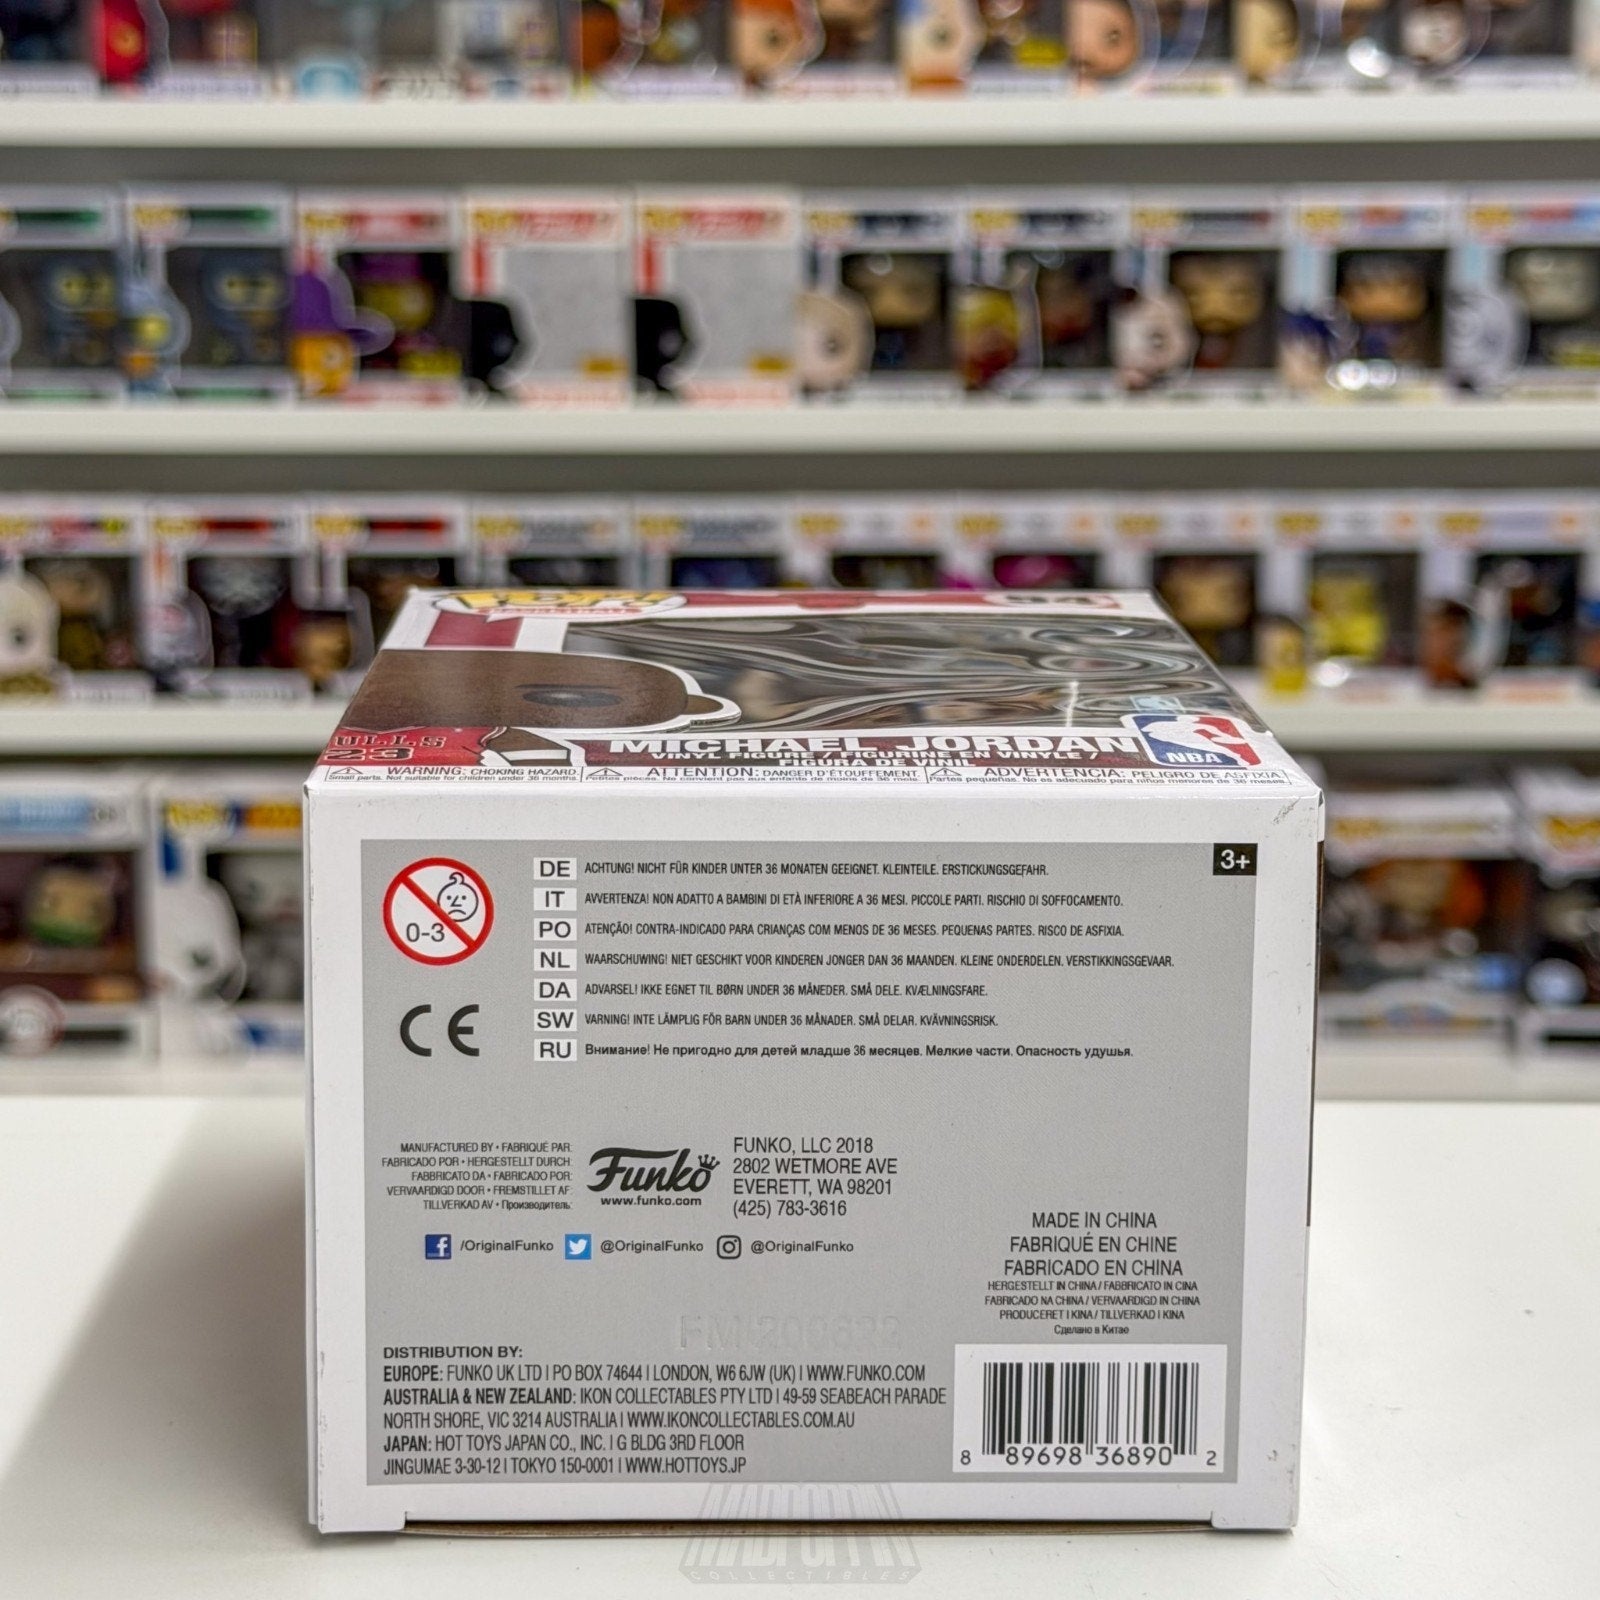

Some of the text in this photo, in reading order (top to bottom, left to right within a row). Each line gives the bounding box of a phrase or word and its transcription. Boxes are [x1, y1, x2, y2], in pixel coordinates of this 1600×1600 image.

[609, 736, 1139, 753] MICHAEL JORDAN
[324, 748, 414, 760] 23
[651, 752, 721, 760] VINYL
[841, 751, 949, 759] FIGURINE
[959, 751, 990, 759] EN
[996, 751, 1082, 760] VINYLE
[1166, 752, 1223, 763] NBA
[779, 758, 976, 767] FIGURA DE VINIL
[388, 766, 580, 776] WARNING: CHOKING HAZARD.
[647, 767, 760, 776] ATTENTION:
[821, 769, 920, 777] D'ÉTOUFFEMENT.
[984, 768, 1126, 777] ADVERTENCIA:
[1132, 770, 1194, 778] PELIGRO
[1221, 849, 1250, 869] 3+
[540, 860, 570, 877] DE
[584, 860, 1048, 878] ACHTUNG! NICHT FÜR KINDER UNTER 36 MONATEN GEEIGNET. KLEINTEILE. ERSTICKUNGSGEFAHR.
[546, 891, 565, 907] IT
[406, 923, 445, 942] 0-3
[540, 921, 571, 938] PO
[540, 952, 570, 968] NL
[540, 982, 571, 998] DA
[537, 1012, 574, 1028] SW
[400, 1004, 479, 1057] CE
[540, 1042, 571, 1058] RU
[586, 1044, 1133, 1059] Внимание! Не пригодно для детей младше 36 месяцев. Мелкие части. Опасность удушья.
[400, 1142, 478, 1152] MANUFACTURED
[481, 1142, 494, 1152] BY
[502, 1141, 548, 1152] FABRIQUÉ
[734, 1137, 873, 1156] FUNKO, LLC 2018
[587, 1148, 720, 1192] Funko
[733, 1158, 898, 1174] 2802 WETMORE AVE
[734, 1178, 890, 1197] EVERETT, WA 98201
[423, 1200, 480, 1210] TILLVERKAD
[481, 1200, 493, 1209] AV
[601, 1195, 702, 1206] www.funko.com
[734, 1200, 846, 1219] (425) 783-3616
[1032, 1212, 1157, 1228] MADE IN CHINA
[460, 1240, 554, 1253] /OriginalFunko
[600, 1240, 703, 1254] @OriginalFunko
[751, 1240, 854, 1254] @OriginalFunko
[1010, 1232, 1177, 1252] FABRIQUÉ EN CHINE
[1004, 1259, 1183, 1276] FABRICADO EN CHINA
[384, 1346, 522, 1358] DISTRIBUTION BY:
[384, 1364, 925, 1384] EUROPE: FUNKO UK LTD PO BOX 74644 LONDON, W6 6JW (UK) WWW.FUNKO.COM
[383, 1387, 946, 1405] AUSTRALIA & NEW ZEALAND: IKON COLLECTABLES PTY LTD 49-59 SEABEACH PARADE
[384, 1434, 744, 1452] JAPAN: HOT TOYS JAPAN CO., INC. G BLDG 3RD FLOOR
[960, 1446, 1216, 1466] 8 89698 36890 2
[384, 1457, 746, 1475] JINGUMAE 3-30-12 TOKYO 150-0001 WWW.HOTTOYS.JP
